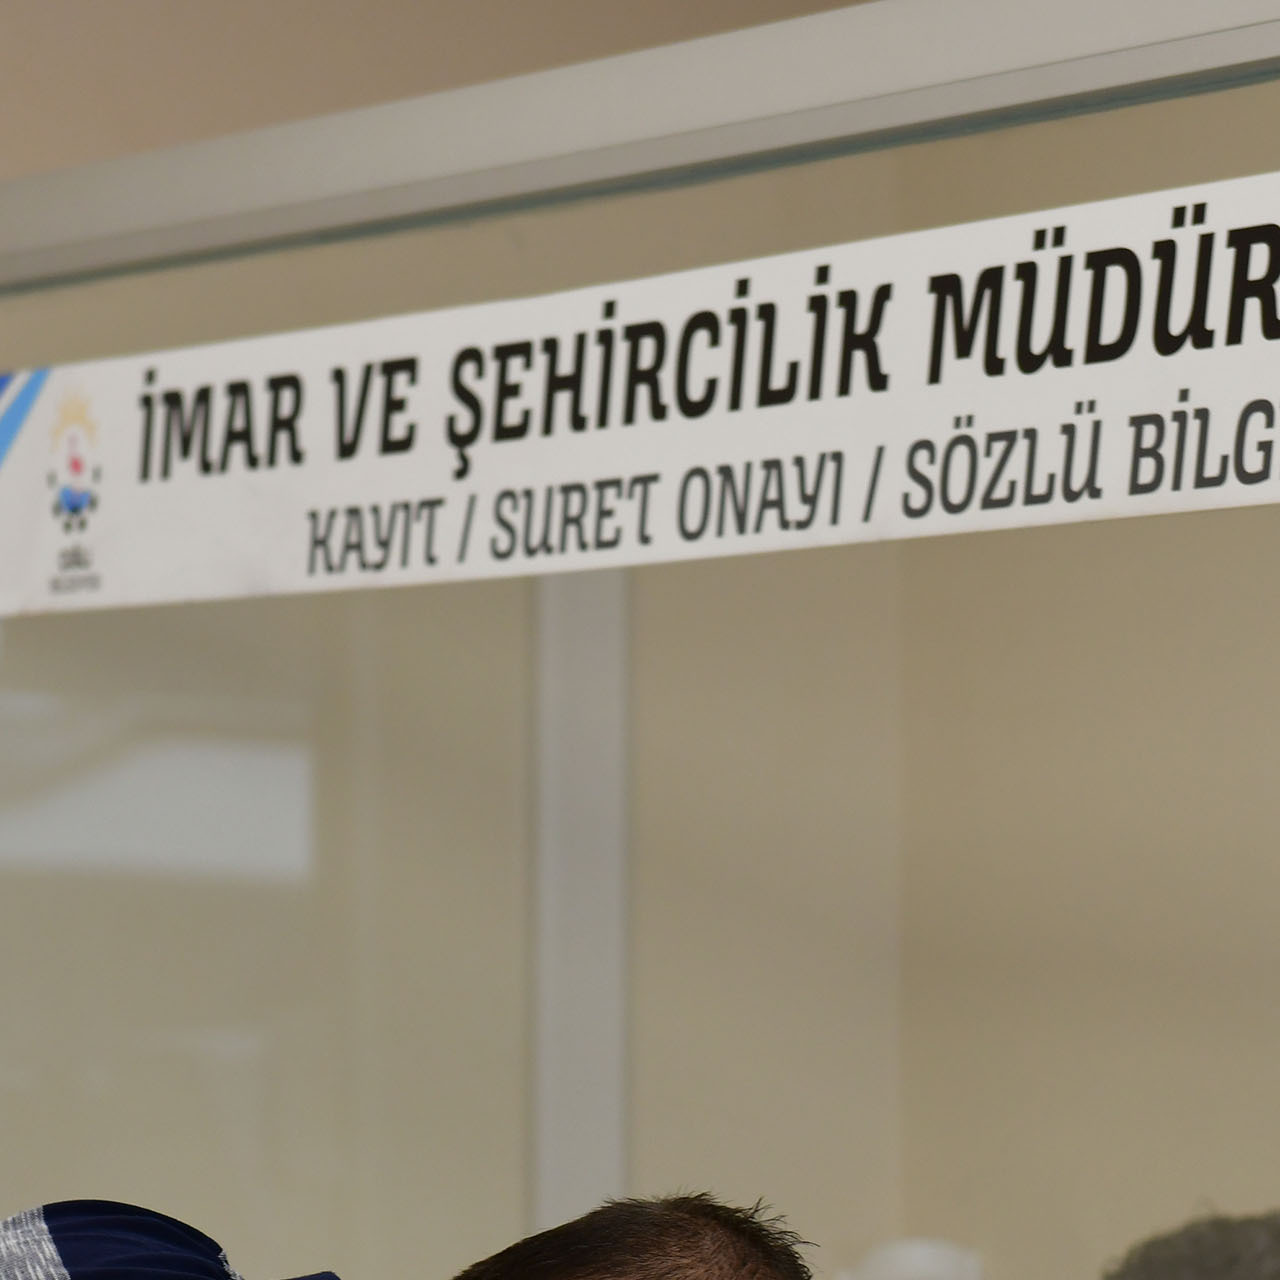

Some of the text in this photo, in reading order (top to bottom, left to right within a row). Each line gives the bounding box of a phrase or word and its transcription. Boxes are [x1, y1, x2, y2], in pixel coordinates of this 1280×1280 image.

[138, 370, 305, 484] İMAR
[331, 358, 420, 456] VE
[446, 264, 895, 480] ŞEHİRCİLİK
[306, 497, 447, 577] KAYIT
[457, 494, 479, 564] /
[489, 473, 660, 561] SURET
[677, 451, 846, 543] ONAYI
[862, 447, 885, 523] /
[901, 401, 1103, 519] SÖZLÜ
